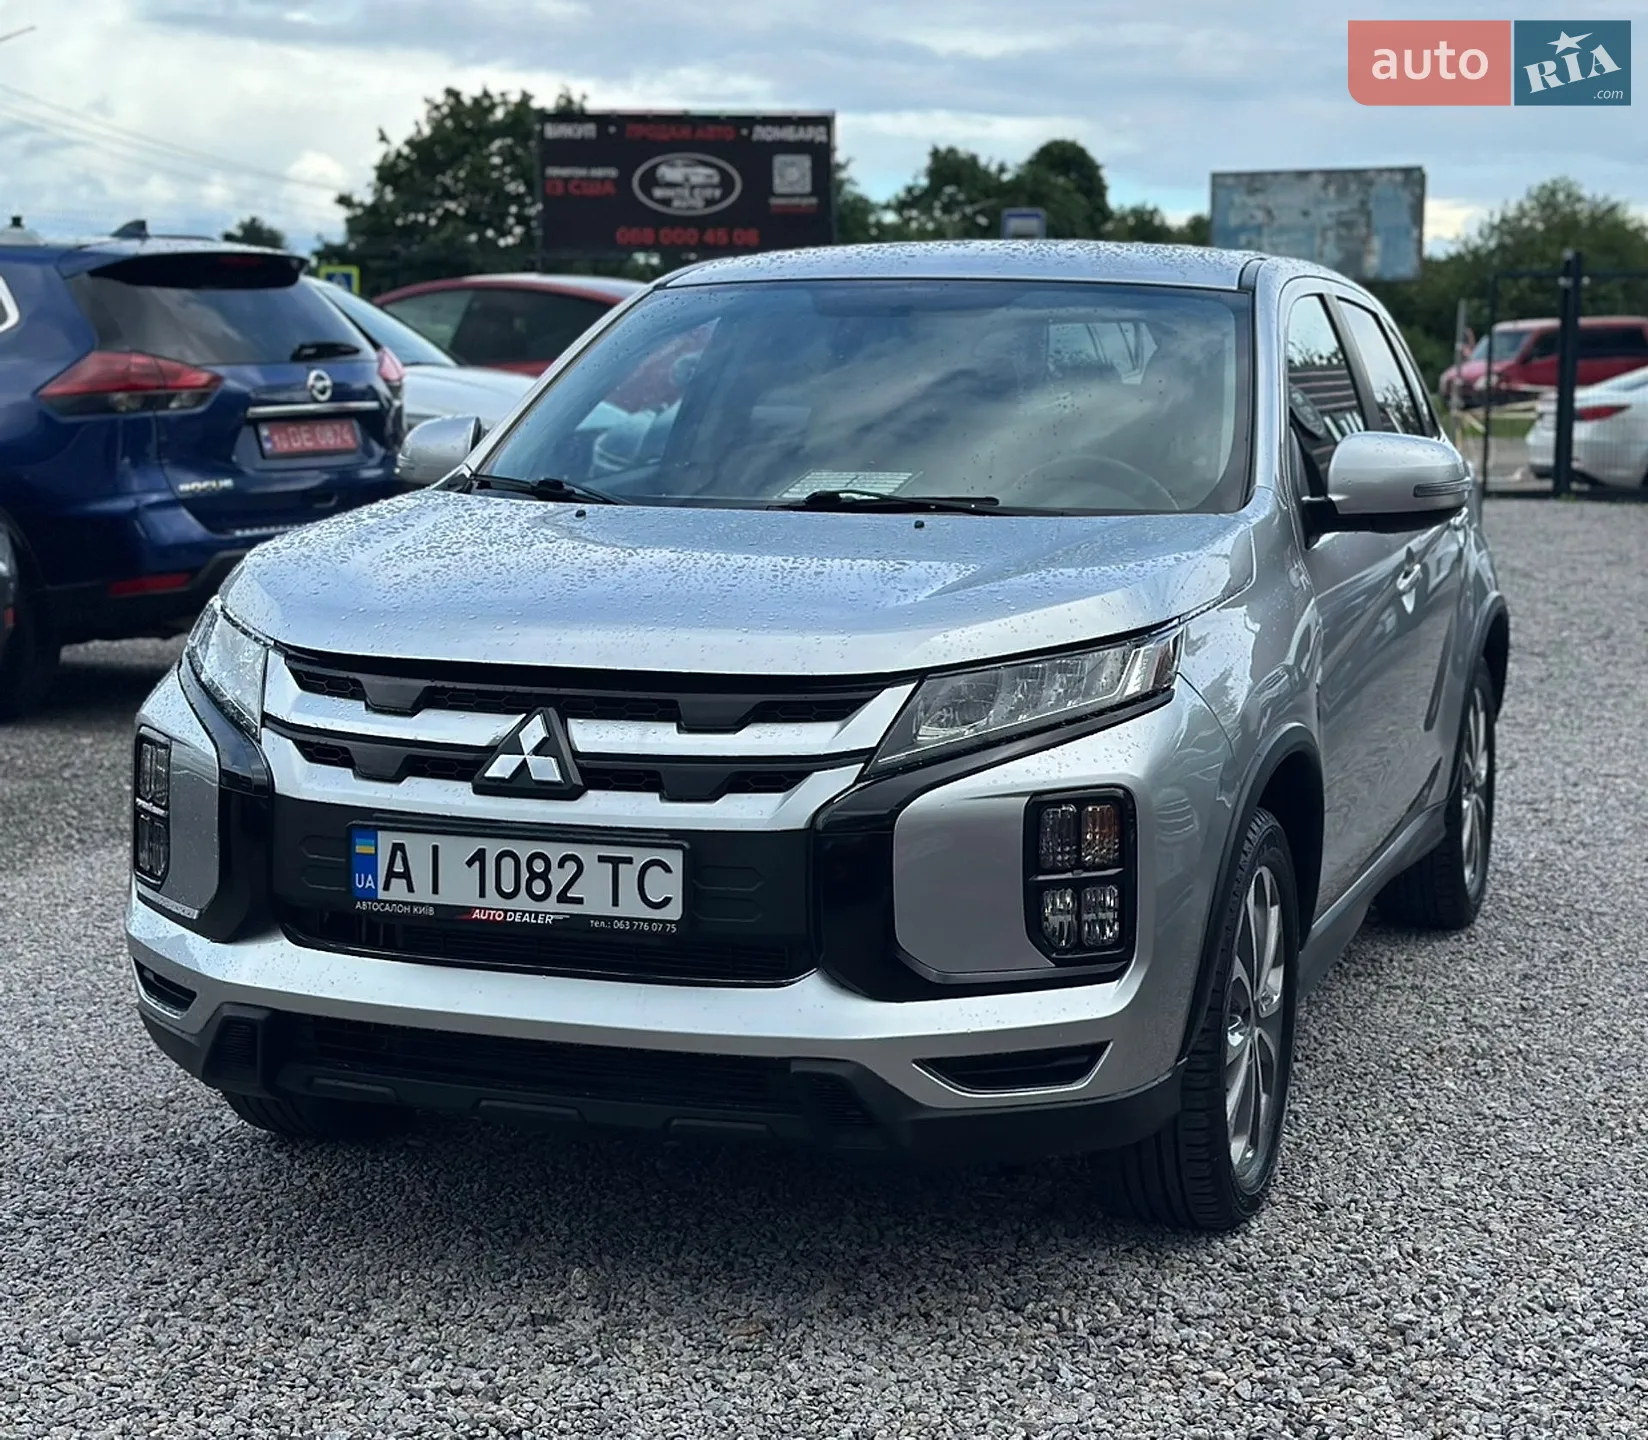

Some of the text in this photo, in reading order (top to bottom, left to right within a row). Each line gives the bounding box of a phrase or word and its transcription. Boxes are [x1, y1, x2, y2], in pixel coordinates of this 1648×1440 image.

[544, 122, 597, 140] ВИКУП
[694, 125, 736, 141] АВТО
[751, 125, 829, 143] ЛОМБАРД
[568, 180, 616, 196] США
[288, 425, 315, 448] DE
[355, 873, 376, 890] UA
[382, 841, 674, 910] AI 1082 TC
[355, 901, 435, 916] АВТОСАЛОН КИЇВ
[472, 909, 554, 925] AUTO DEALER
[613, 920, 631, 930] 063
[633, 921, 650, 931] 776
[651, 922, 664, 932] 07
[665, 923, 677, 933] 75
